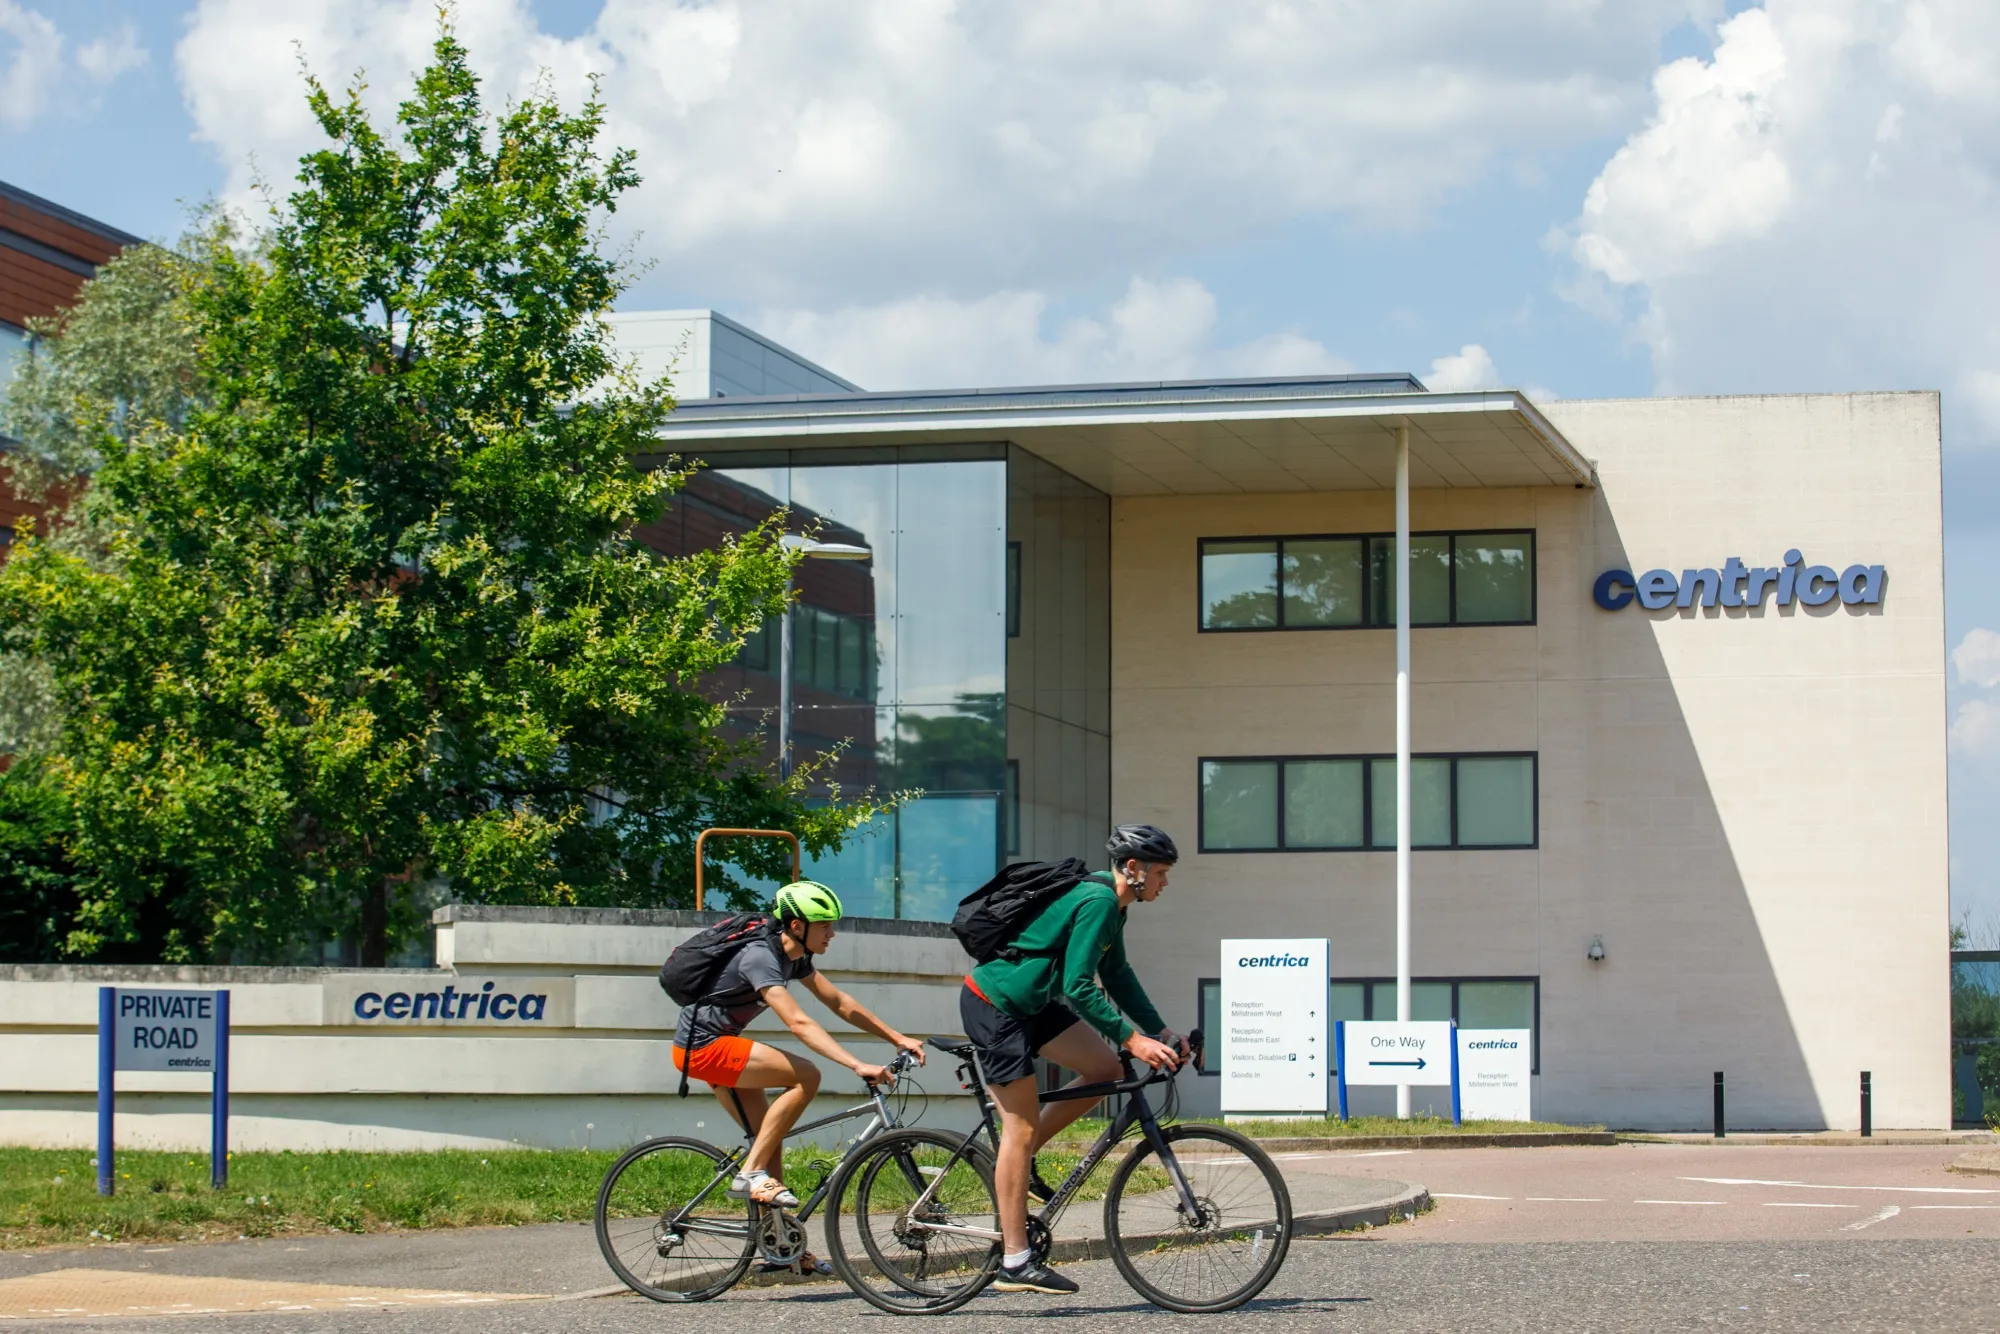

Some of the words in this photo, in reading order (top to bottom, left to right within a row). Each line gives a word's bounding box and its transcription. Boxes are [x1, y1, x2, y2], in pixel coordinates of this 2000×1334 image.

[1593, 548, 1885, 611] centrica
[1239, 953, 1309, 968] centrica
[121, 995, 212, 1019] PRIVATE
[355, 982, 547, 1020] centrica
[133, 1027, 198, 1049] ROAD
[1371, 1036, 1395, 1048] One
[1398, 1036, 1426, 1051] Way
[1468, 1039, 1518, 1049] centrica
[168, 1057, 211, 1067] centrica
[1477, 1072, 1509, 1080] Reception
[1046, 1150, 1097, 1214] BOARDMAN
